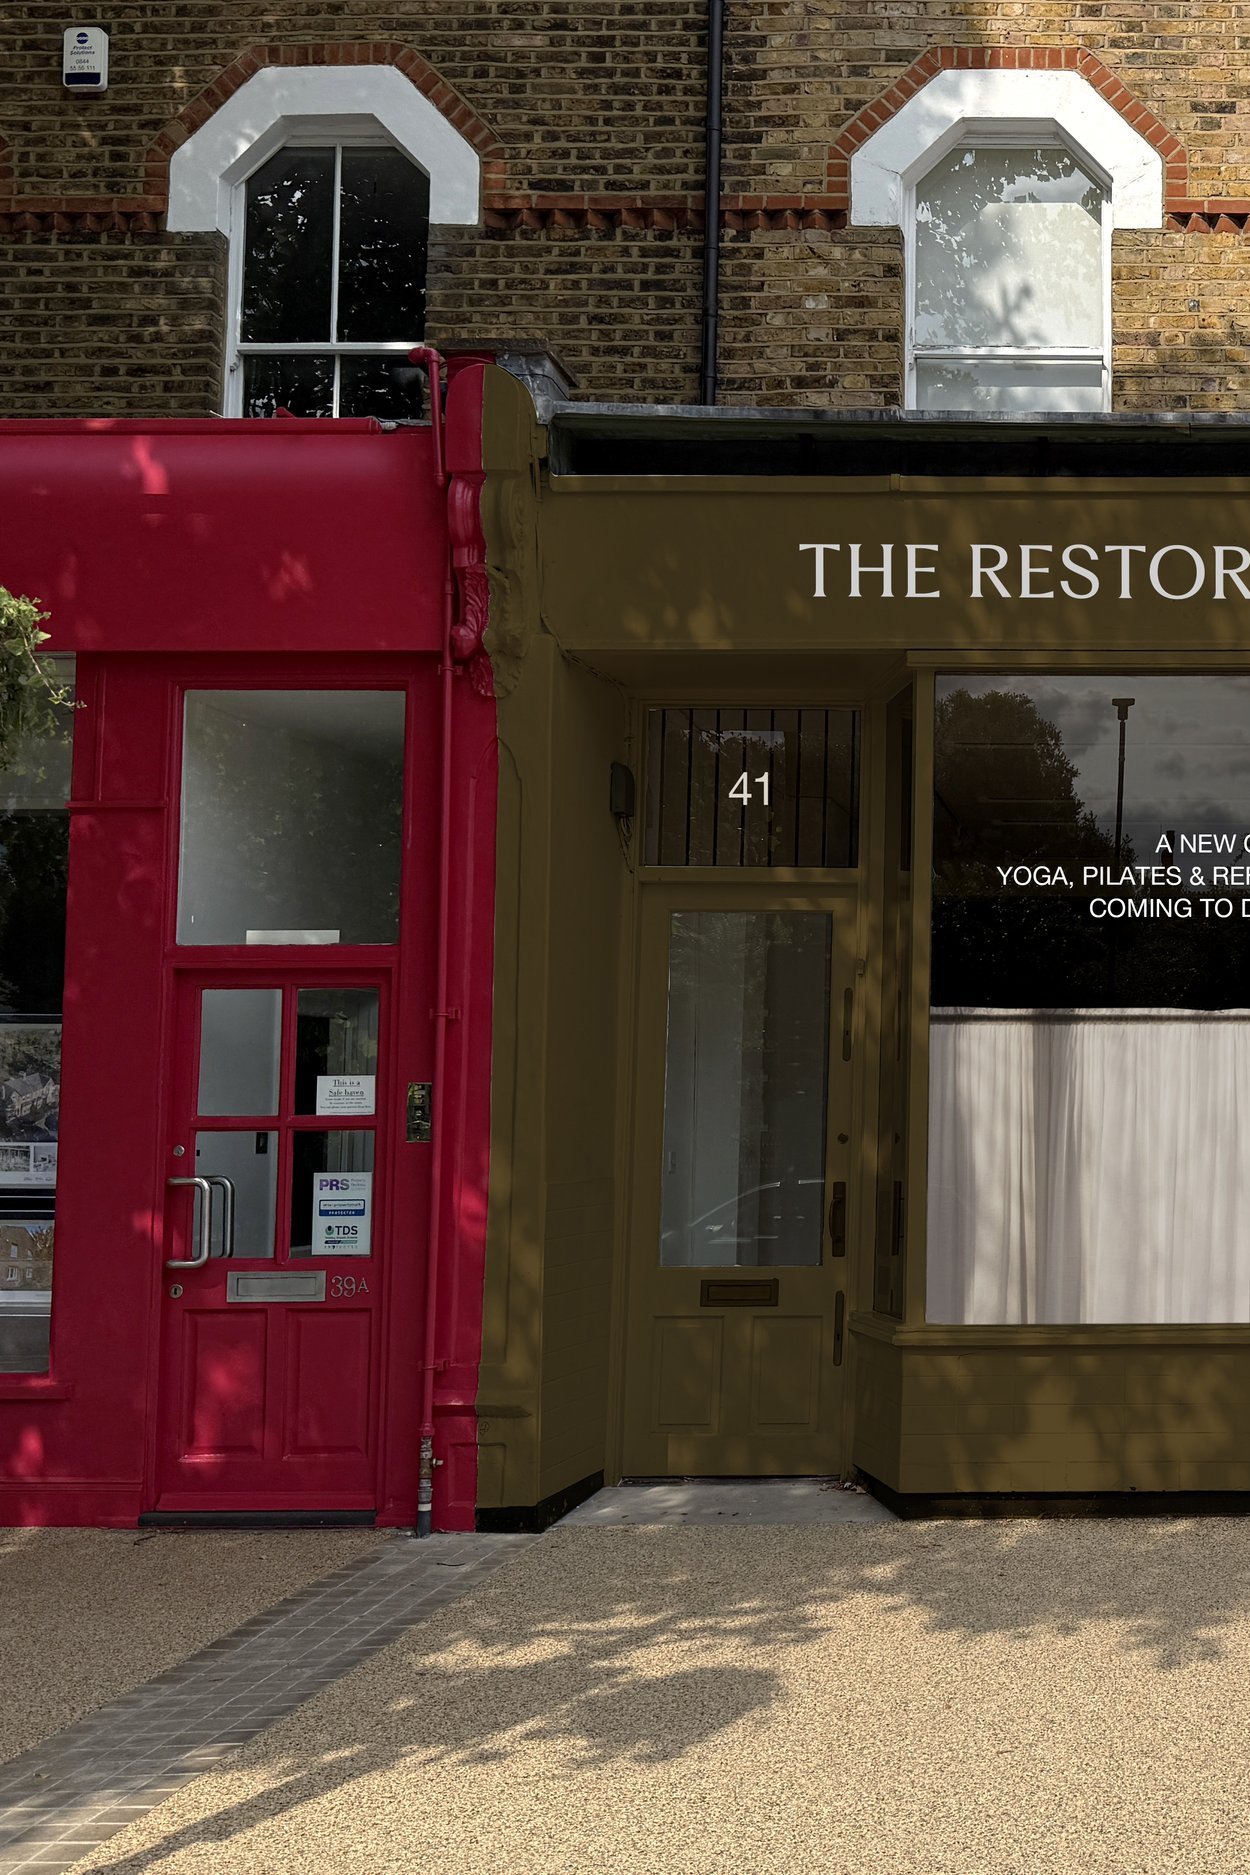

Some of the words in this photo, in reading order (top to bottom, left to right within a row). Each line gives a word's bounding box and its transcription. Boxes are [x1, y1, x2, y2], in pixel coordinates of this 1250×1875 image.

[799, 543, 940, 598] THE
[728, 771, 769, 806] 41
[1155, 834, 1173, 853] A
[1180, 834, 1237, 853] NEW
[996, 865, 1074, 889] YOGA,
[1083, 865, 1182, 886] PILATES
[1189, 866, 1206, 886] &
[1089, 898, 1191, 918] COMING
[1199, 898, 1233, 918] TO
[319, 1178, 351, 1191] PRS
[334, 1225, 359, 1236] TDS
[330, 1275, 370, 1298] 39A
